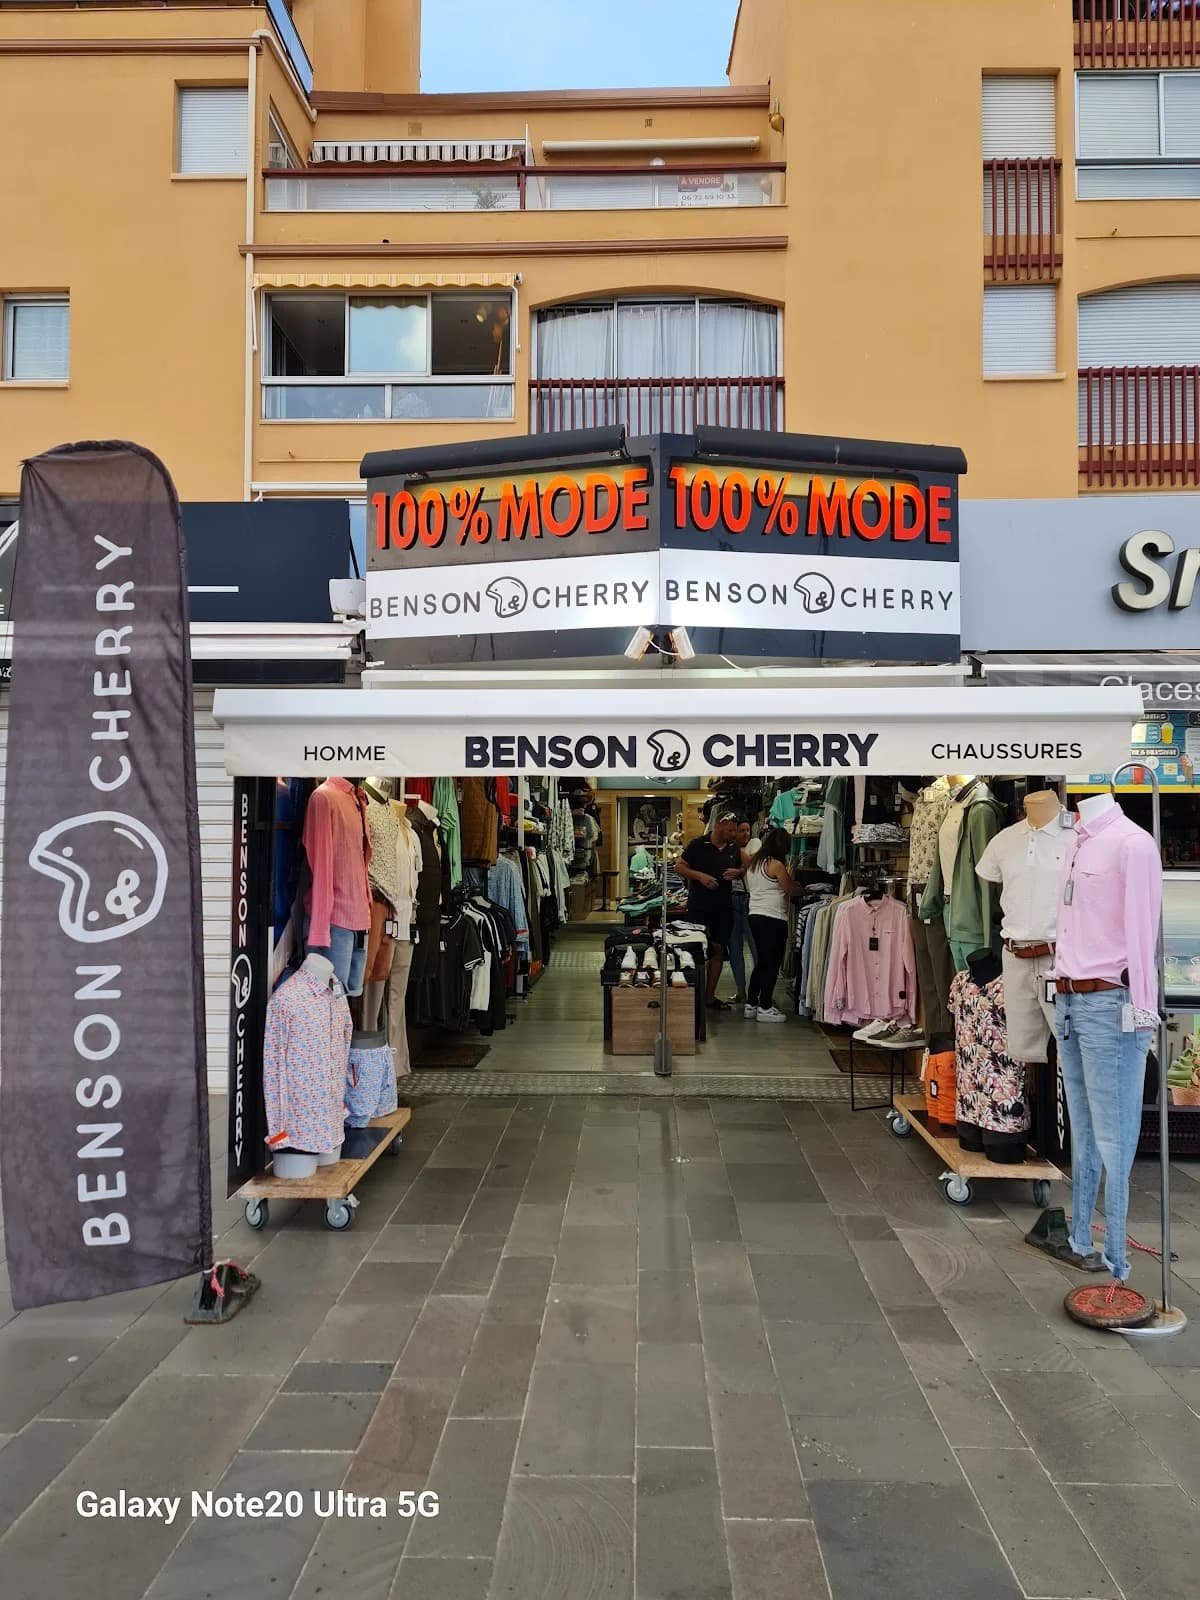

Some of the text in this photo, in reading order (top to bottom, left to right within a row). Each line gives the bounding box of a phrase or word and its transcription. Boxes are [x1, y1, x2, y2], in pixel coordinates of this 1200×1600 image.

[688, 175, 721, 185] VENDRE
[371, 468, 650, 550] 100% MODE
[669, 466, 952, 544] 100% MODE
[370, 591, 481, 619] BENSON
[532, 579, 650, 609] CHERRY
[665, 579, 788, 605] BENSON
[840, 587, 953, 611] CHERRY
[89, 534, 136, 792] CHERRY
[303, 745, 386, 761] HOMME
[464, 735, 637, 769] BENSON
[702, 733, 879, 768] CHERRY
[931, 743, 1083, 760] CHAUSSURES
[237, 793, 249, 949] BENSON
[74, 964, 131, 1246] BENSON
[234, 1013, 246, 1167] CHERRY
